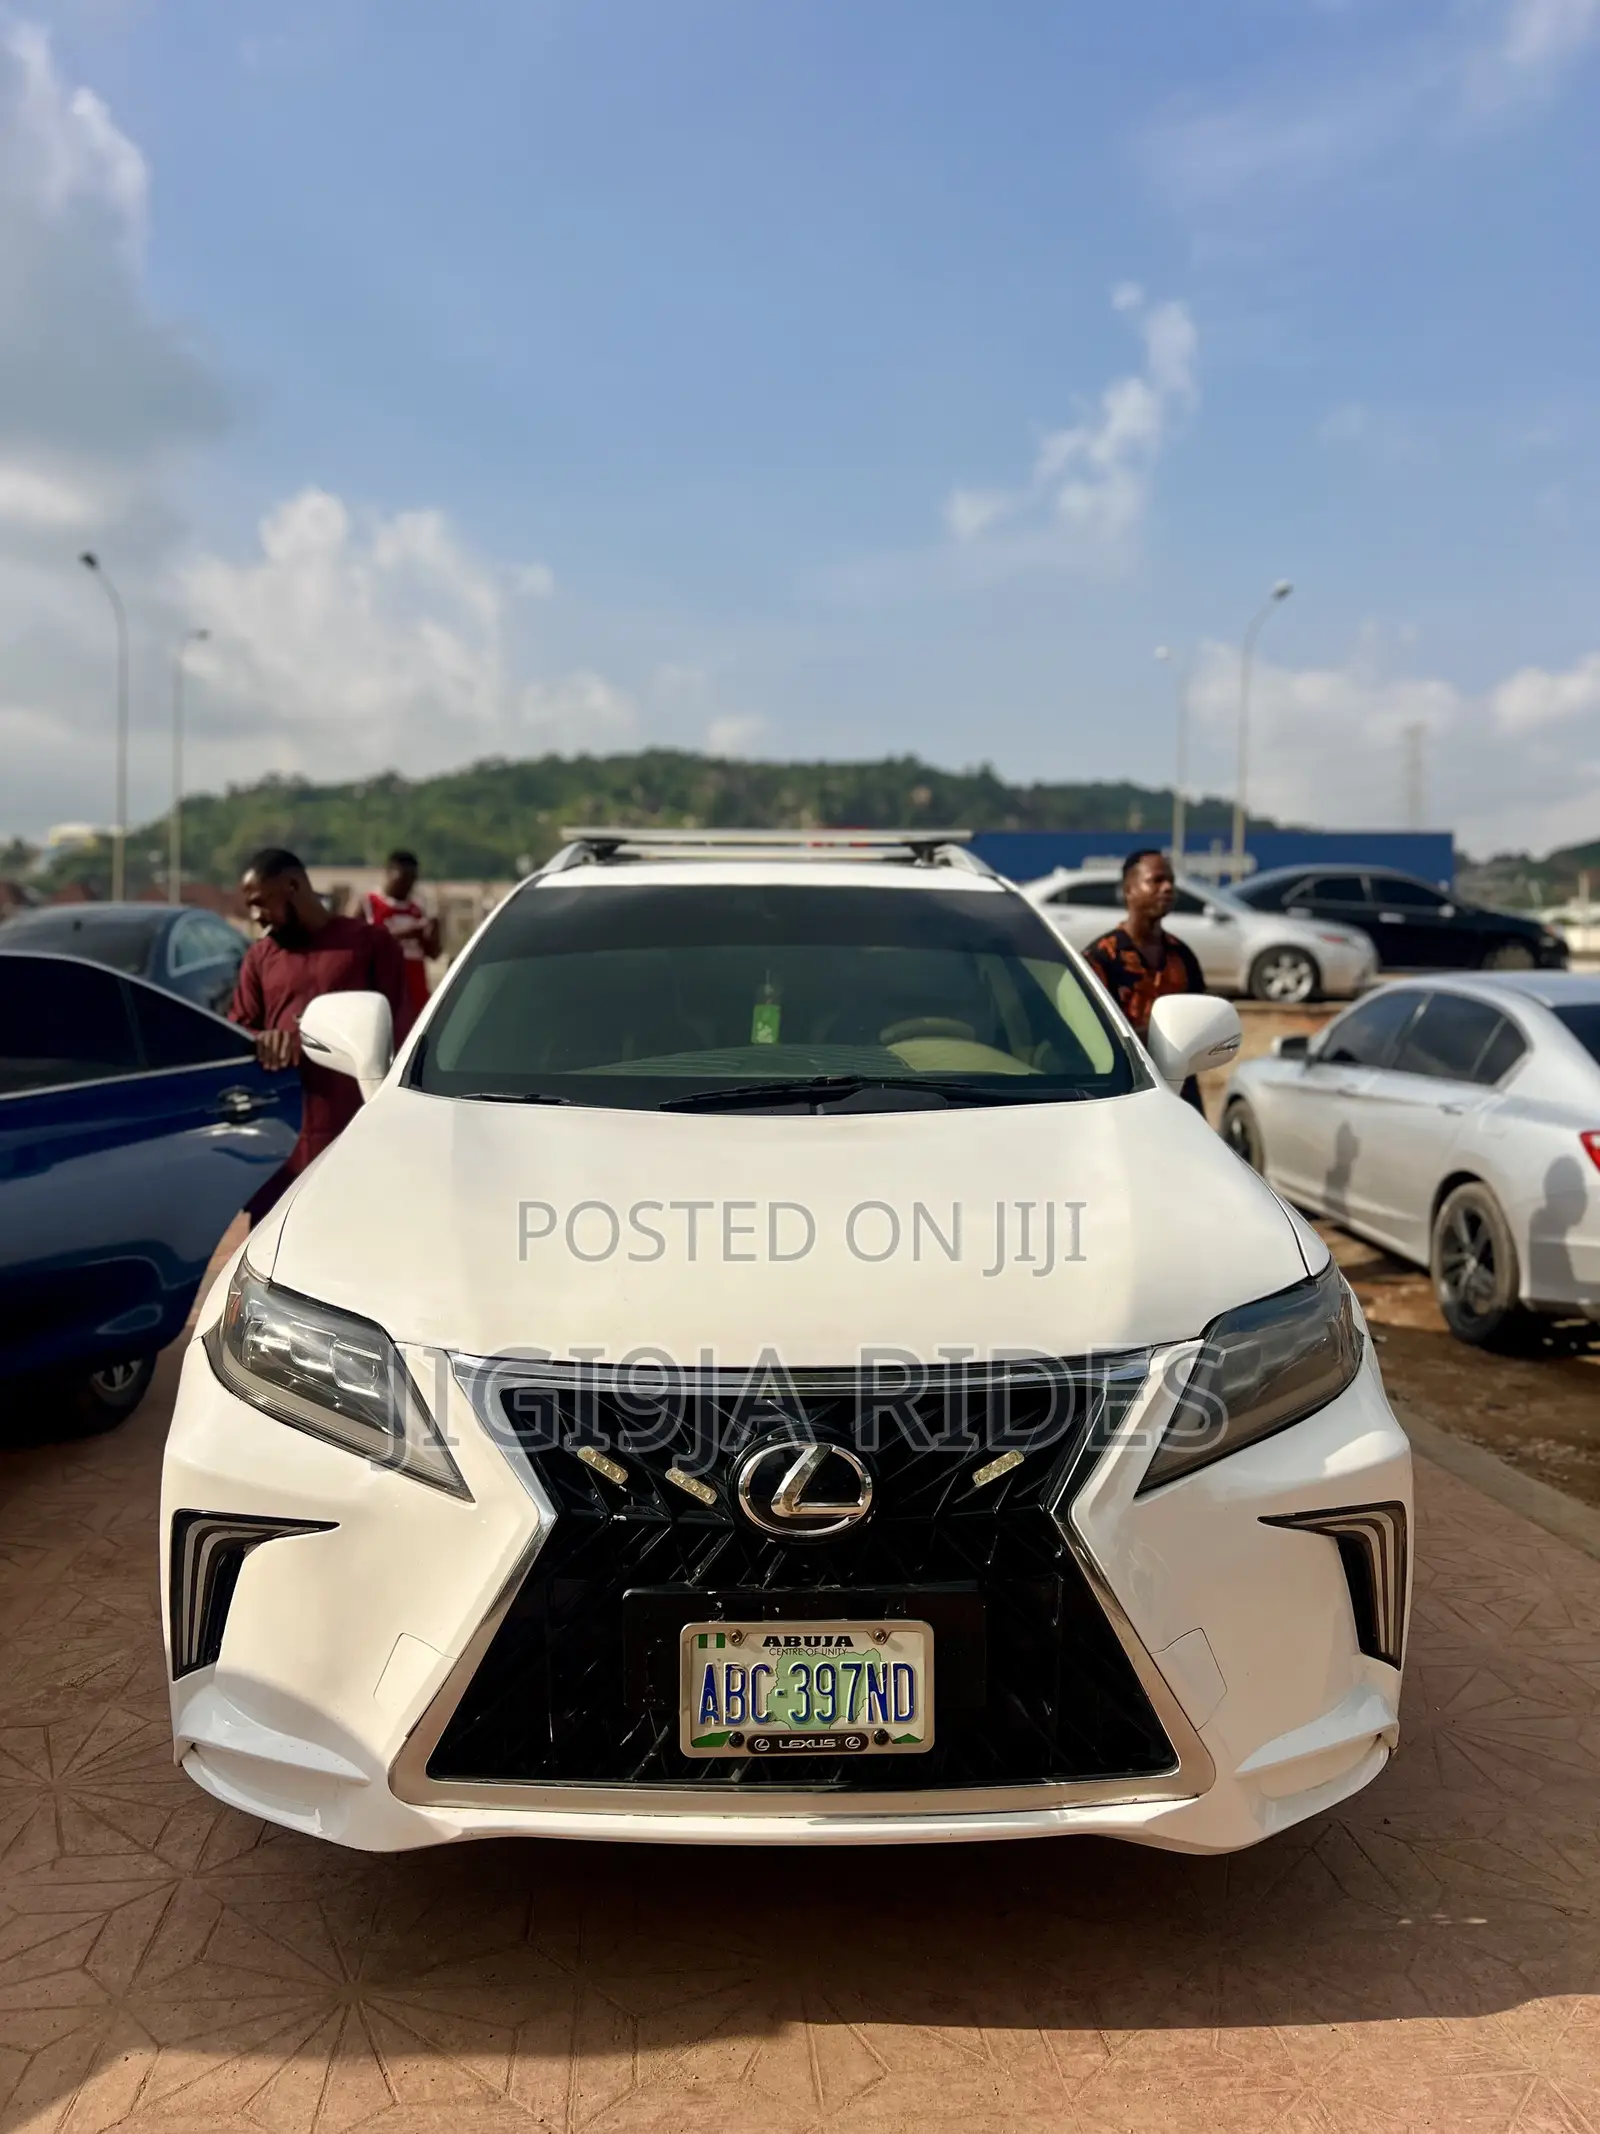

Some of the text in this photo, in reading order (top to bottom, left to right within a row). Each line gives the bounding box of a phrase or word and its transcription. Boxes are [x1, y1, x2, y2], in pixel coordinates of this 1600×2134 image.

[762, 1636, 854, 1647] ABUJA
[769, 1648, 847, 1656] CENTRE OF UNITY
[699, 1662, 916, 1725] ABC-397ND
[779, 1739, 836, 1749] LEXUS
